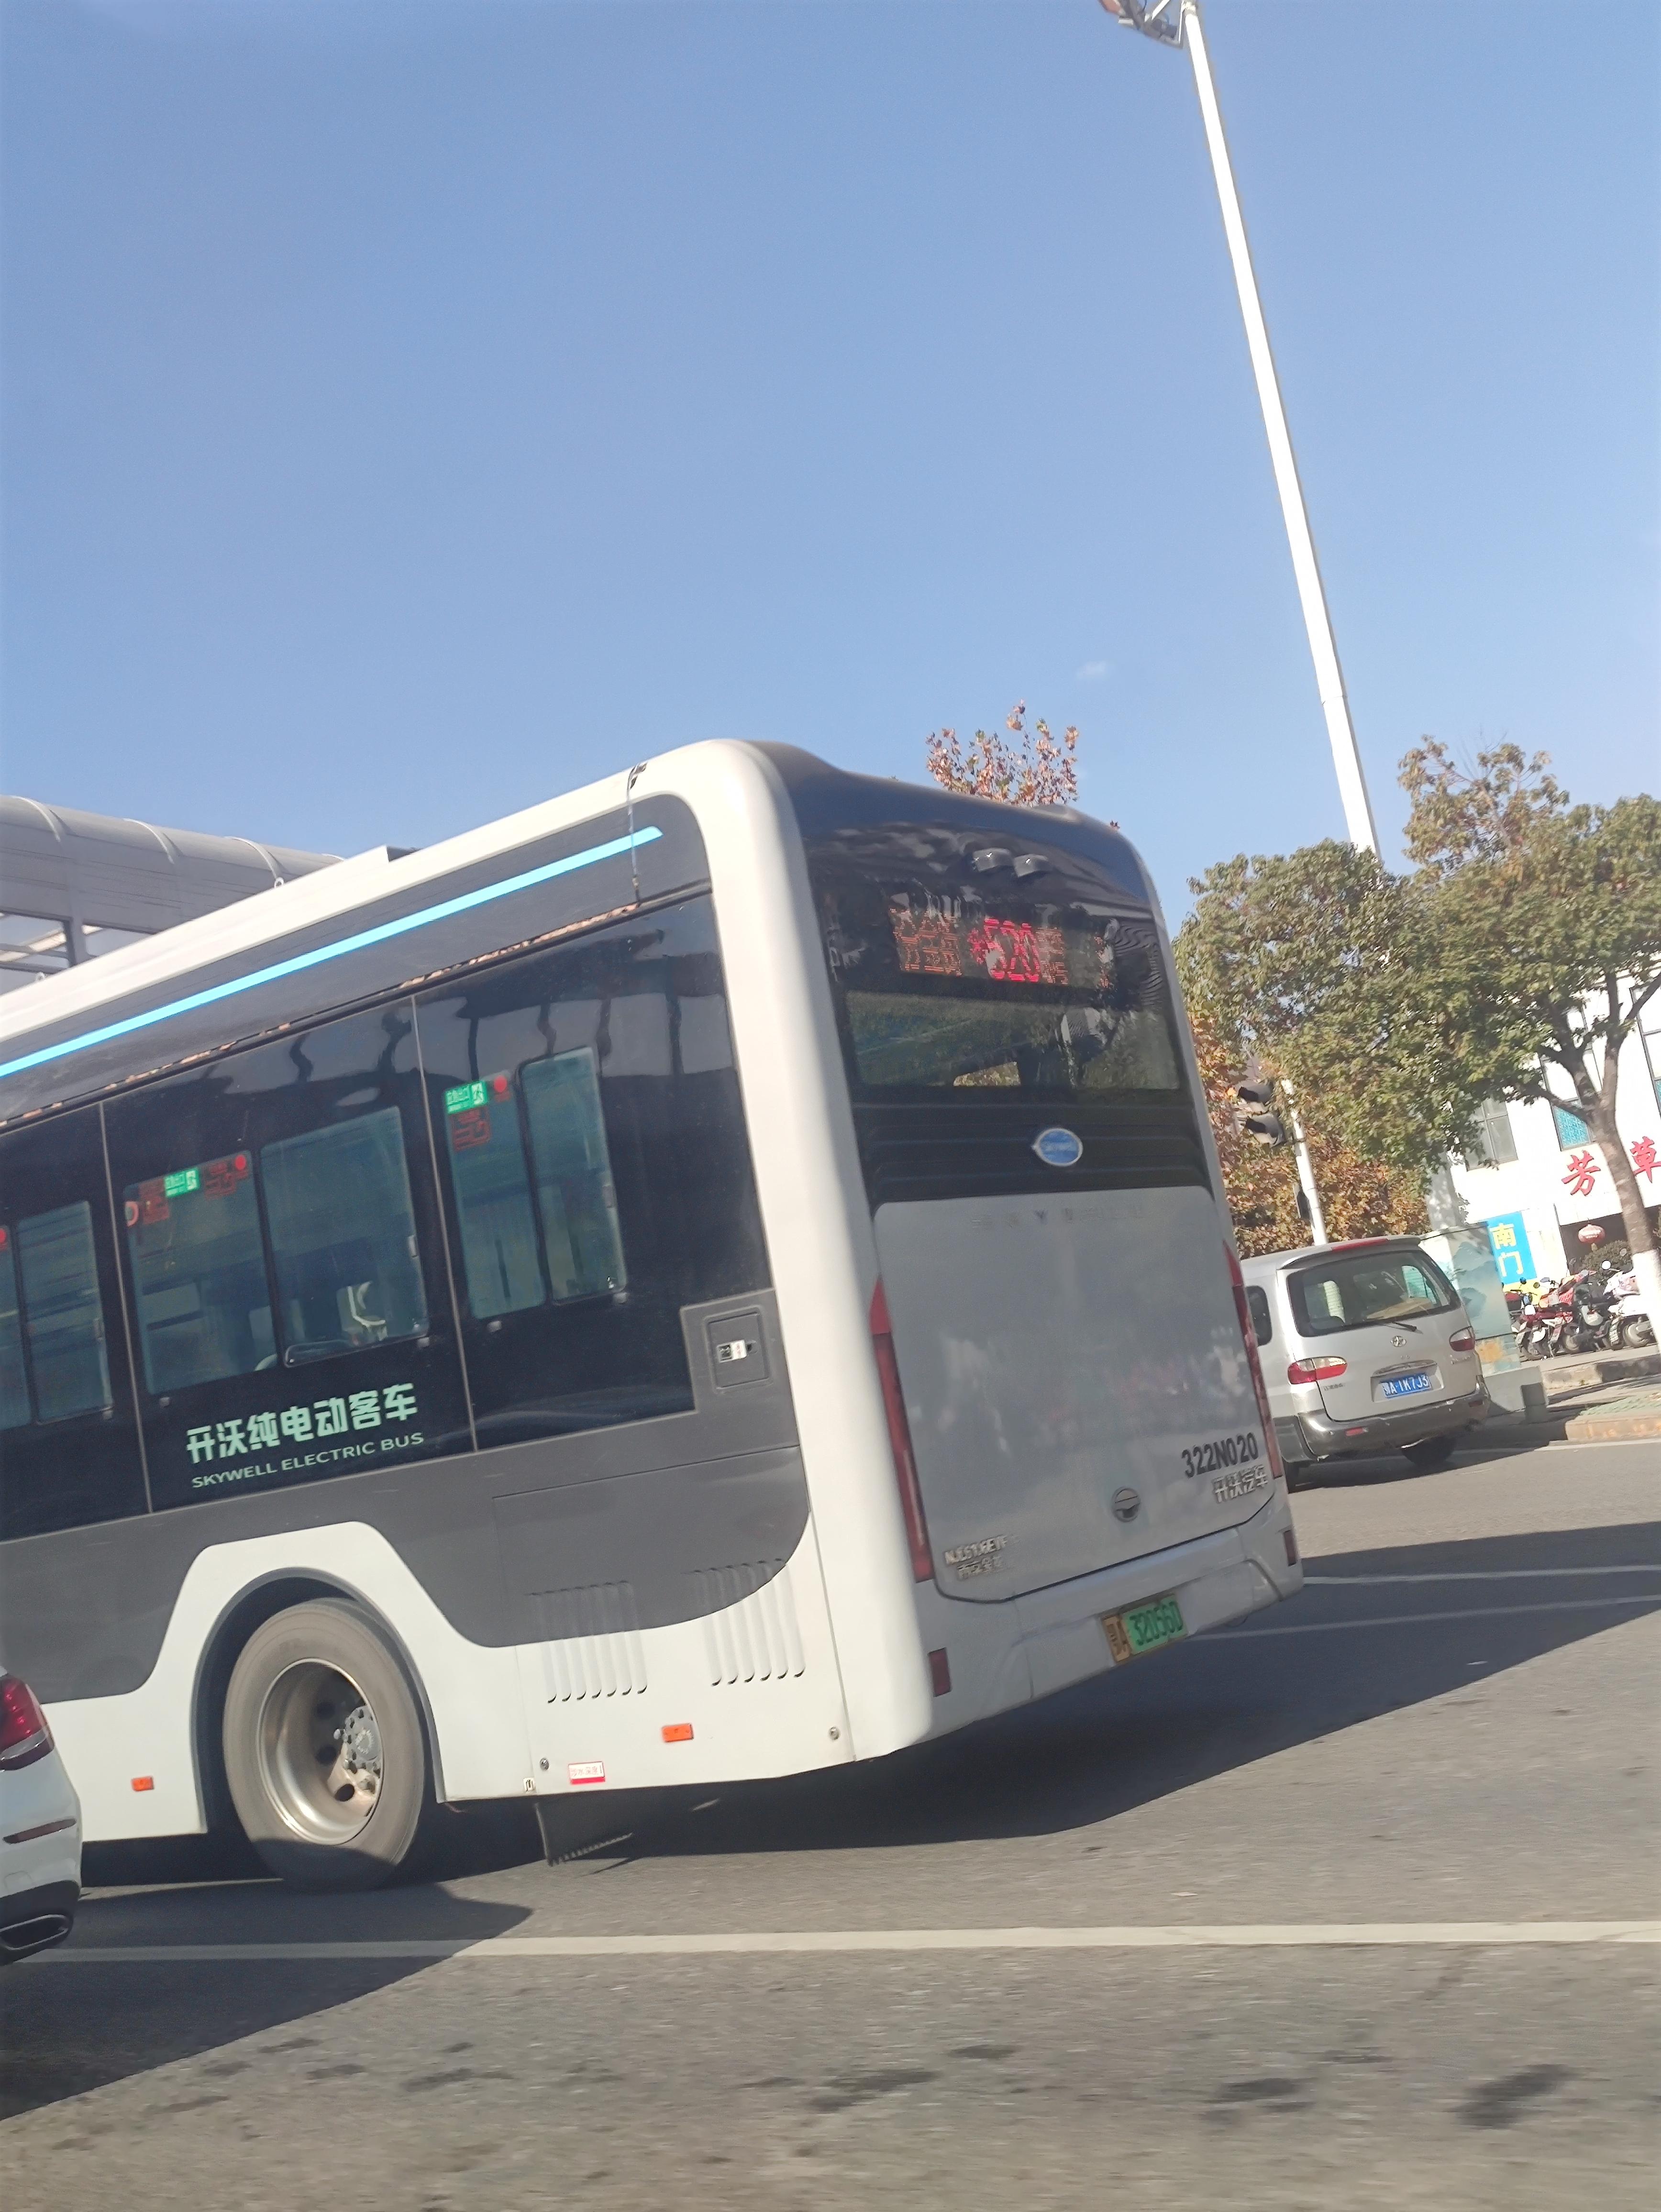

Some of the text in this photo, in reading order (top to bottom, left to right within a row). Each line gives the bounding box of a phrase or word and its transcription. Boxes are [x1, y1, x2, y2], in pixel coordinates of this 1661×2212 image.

[1489, 1222, 1524, 1278] 南门
[186, 1382, 418, 1464] 开沃纯电动客车
[191, 1432, 424, 1488] SKYWELL ELECTRIC BUS
[1181, 1432, 1259, 1478] 322N020
